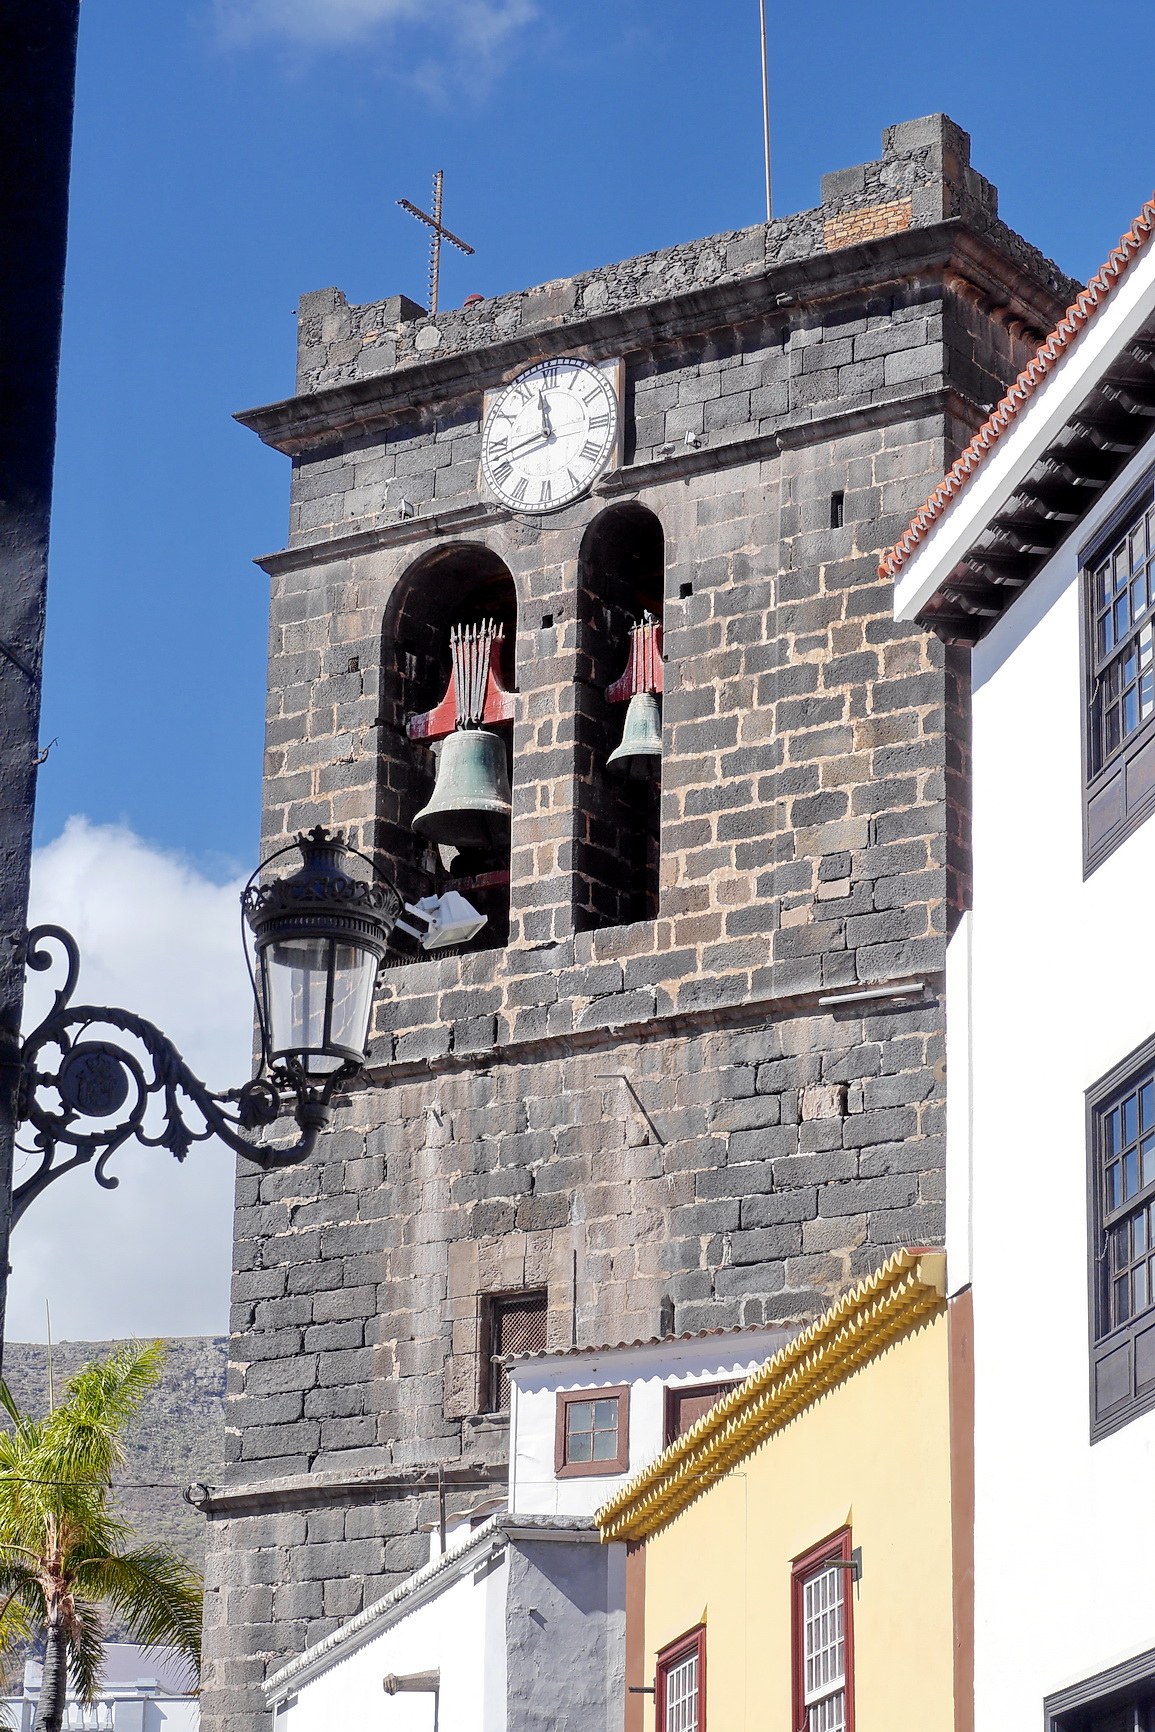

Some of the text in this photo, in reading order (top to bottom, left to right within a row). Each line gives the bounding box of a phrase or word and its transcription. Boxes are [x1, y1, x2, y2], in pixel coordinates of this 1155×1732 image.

[540, 367, 560, 392] XII
[567, 369, 581, 390] I
[514, 381, 535, 407] XI
[582, 385, 603, 408] II
[496, 408, 518, 428] X
[588, 412, 609, 431] III
[489, 435, 508, 456] IX
[579, 439, 603, 464] IIII
[492, 461, 513, 488] VIII
[567, 467, 580, 488] V
[510, 477, 529, 502] VII
[539, 480, 552, 502] VI
